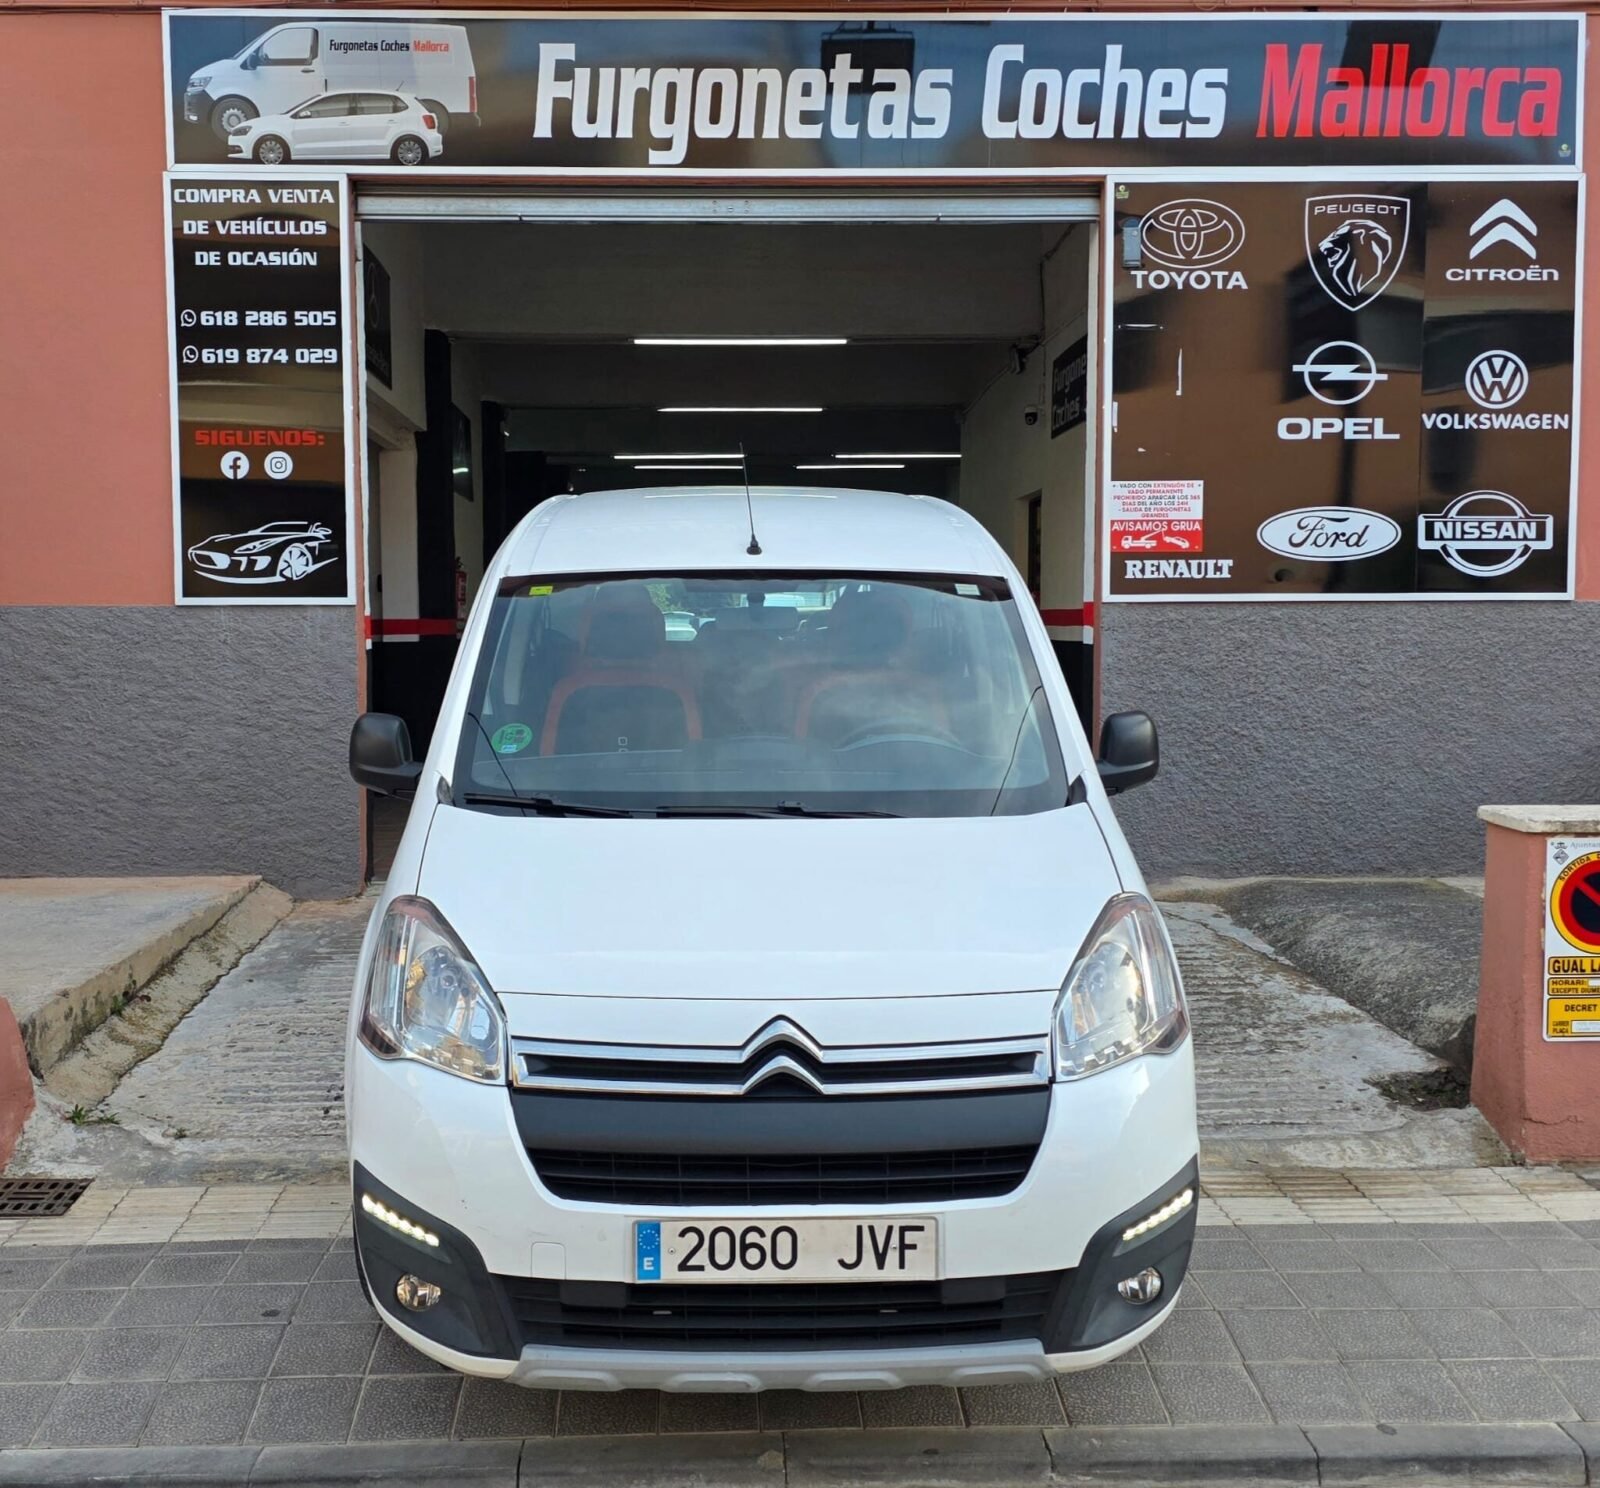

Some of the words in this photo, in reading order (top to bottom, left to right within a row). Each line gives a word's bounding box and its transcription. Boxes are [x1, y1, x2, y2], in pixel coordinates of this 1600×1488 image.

[330, 39, 378, 54] Furgonetas
[381, 40, 410, 52] Coches
[413, 40, 449, 52] Mallorca
[533, 43, 953, 165] Furgonetas
[981, 44, 1228, 139] Coches
[1256, 43, 1562, 138] Mallorca
[174, 188, 261, 204] COMPRA
[268, 188, 335, 204] VENTA
[1314, 203, 1401, 216] PEUGEOT
[183, 220, 209, 235] DE
[216, 216, 327, 236] VEHÍCULOS
[195, 251, 221, 266] DE
[227, 249, 317, 267] OCASIÓN
[1130, 270, 1248, 290] TOYOTA
[1445, 265, 1560, 282] CITROËN
[200, 310, 239, 326] 618
[245, 310, 288, 326] 286
[294, 310, 337, 326] 505
[201, 348, 240, 364] 619
[246, 348, 289, 364] 874
[295, 348, 338, 364] 029
[1277, 418, 1400, 440] OPEL
[1422, 413, 1569, 430] VOLKSWAGEN
[195, 430, 325, 446] SIGUENOS:
[1112, 521, 1168, 532] AVISAMOS
[1171, 521, 1201, 531] GRUA
[1289, 515, 1369, 548] Ford
[1434, 521, 1536, 539] NISSAN
[1125, 559, 1233, 579] RENAULT
[1559, 856, 1591, 880] SORTIDA
[1552, 959, 1586, 973] GUAL
[1564, 1004, 1597, 1012] DECRET
[643, 1257, 654, 1270] E
[677, 1225, 798, 1272] 2060
[837, 1225, 925, 1270] JVF
